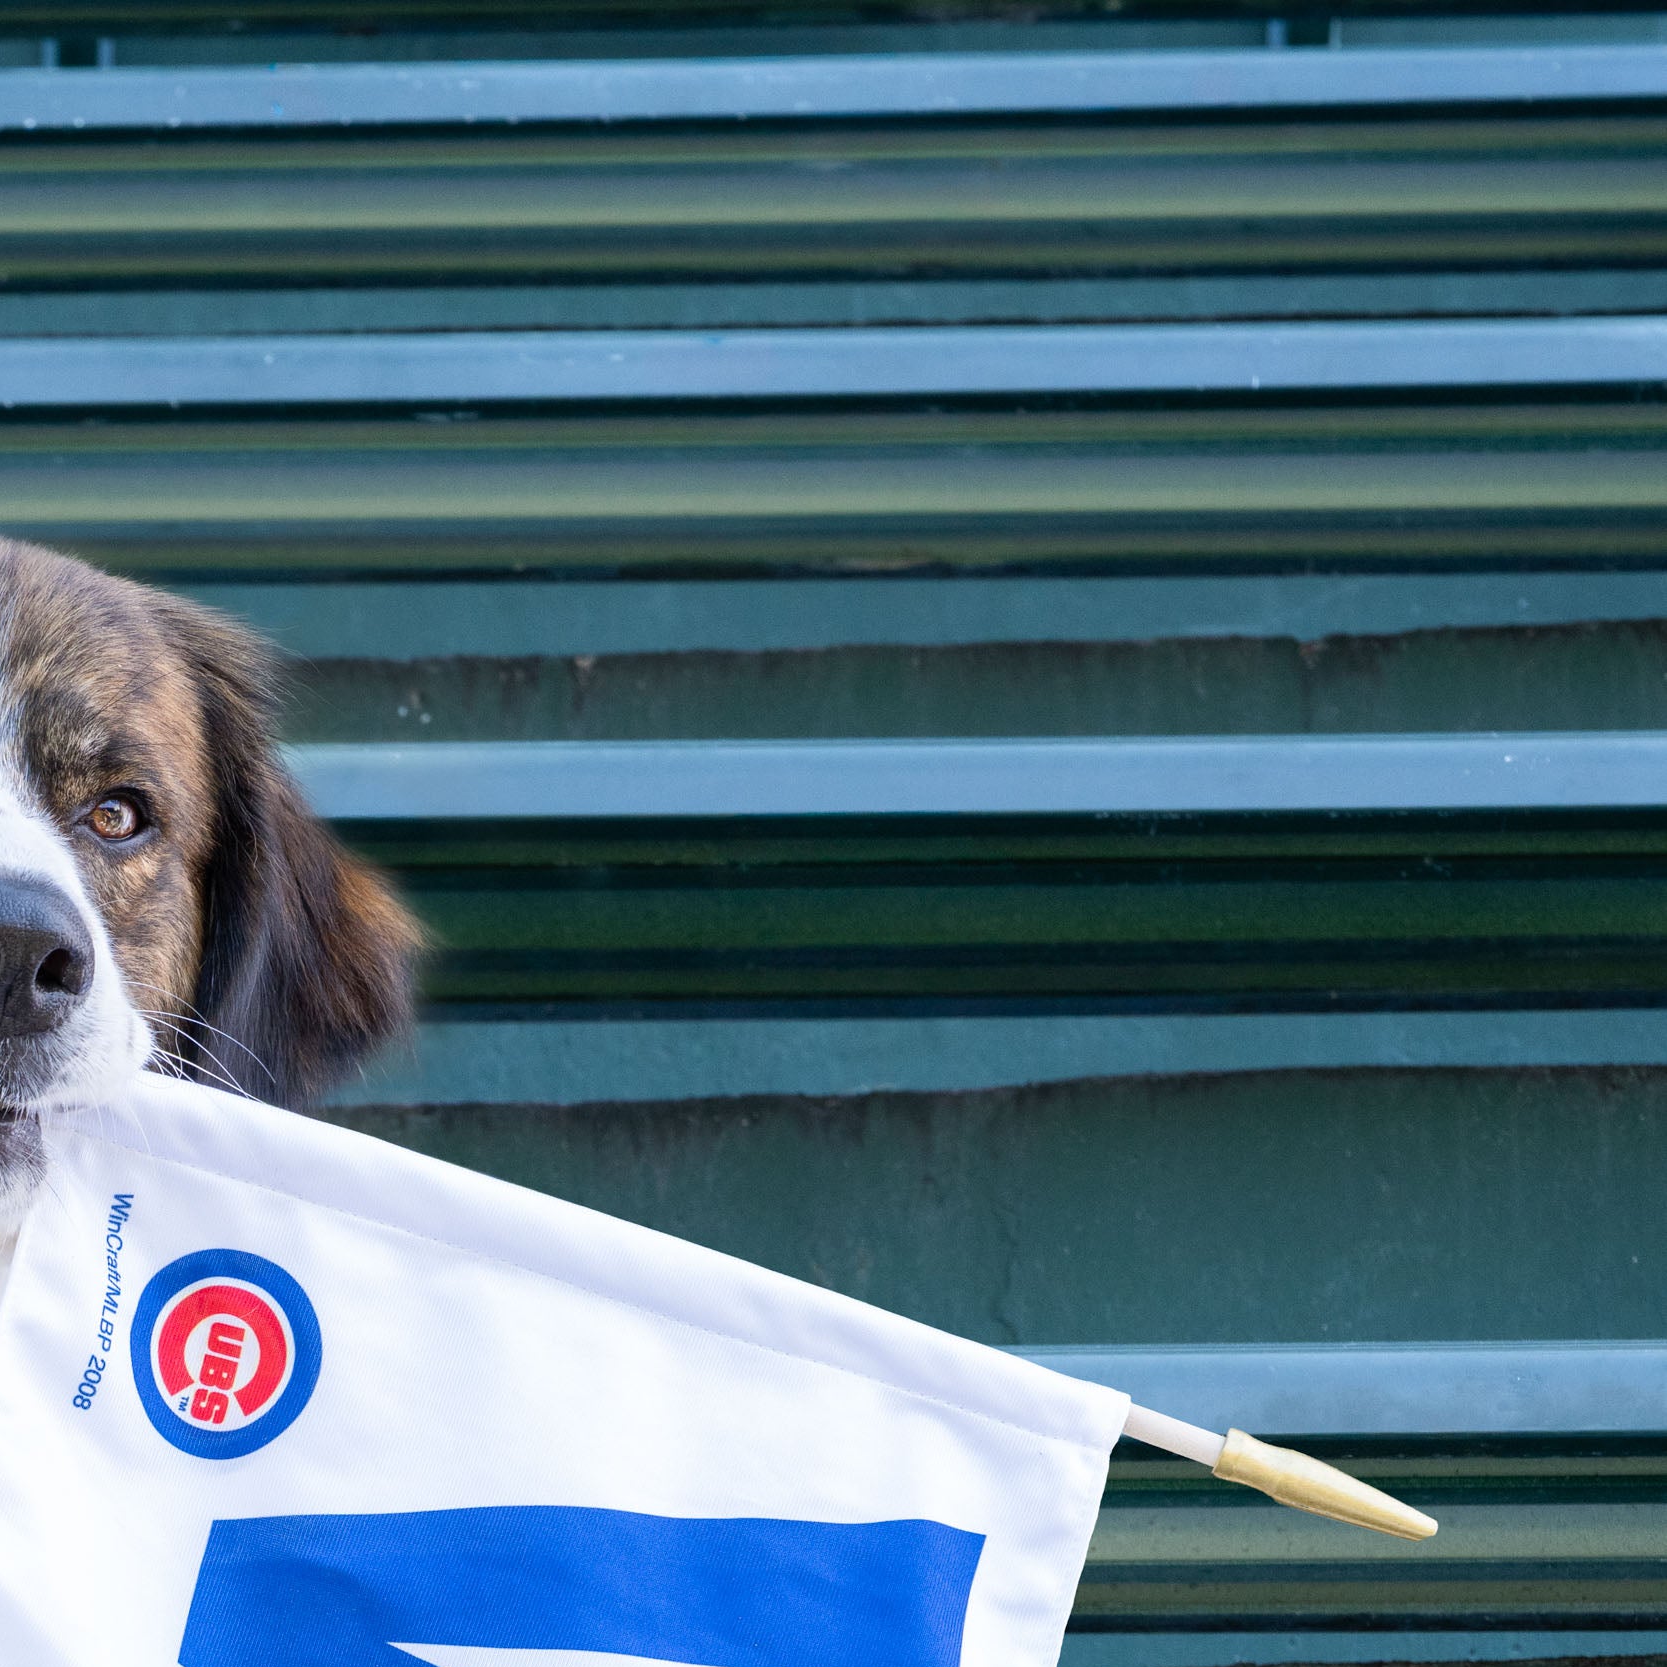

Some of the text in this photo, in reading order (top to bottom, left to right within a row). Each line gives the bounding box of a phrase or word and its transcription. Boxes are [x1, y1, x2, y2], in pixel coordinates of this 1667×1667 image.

[72, 1193, 134, 1410] WinCraft/MLBP 2008
[158, 1285, 287, 1424] CUBS
